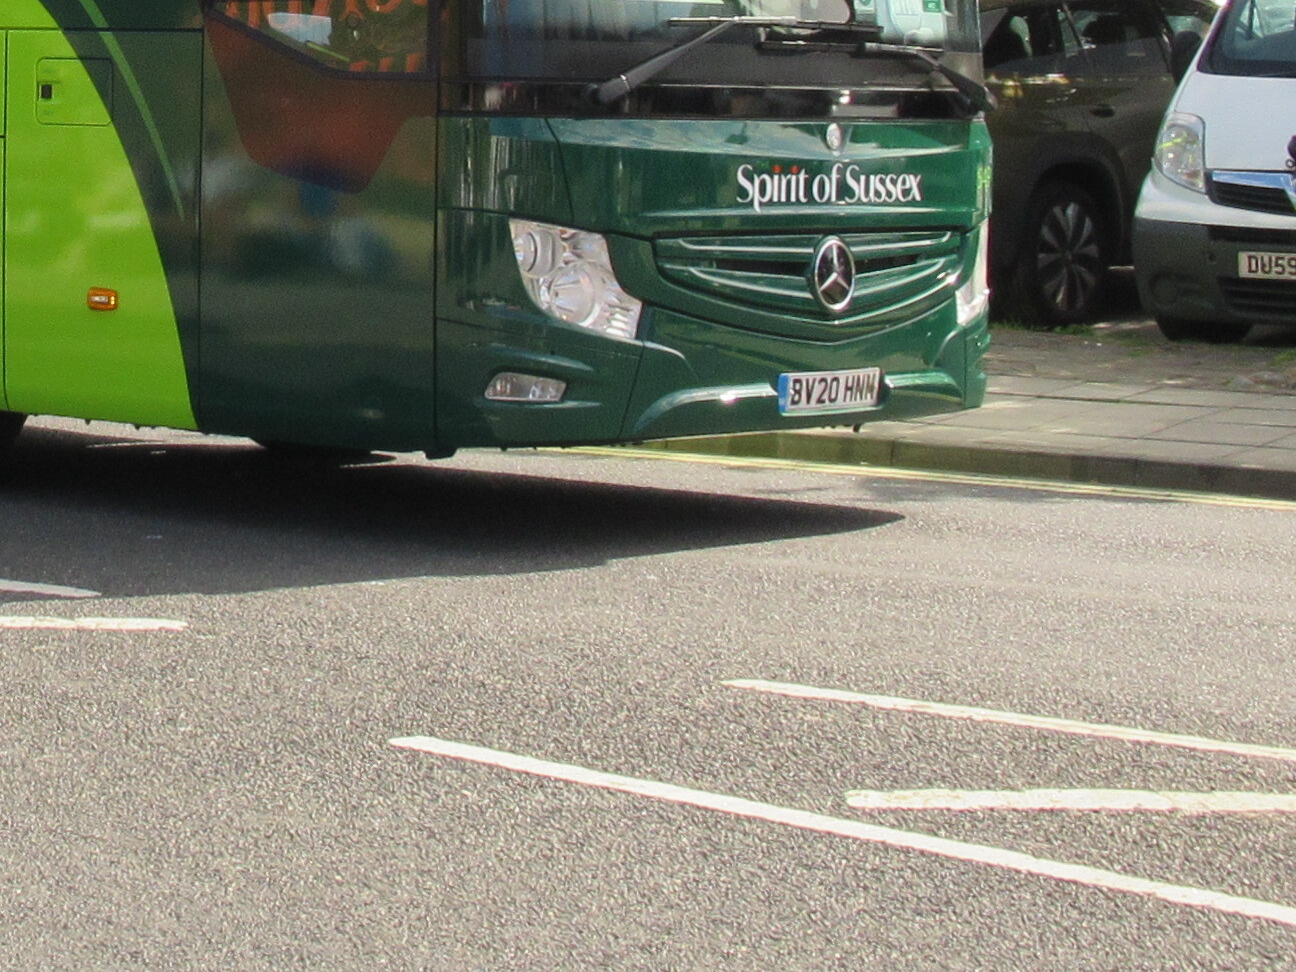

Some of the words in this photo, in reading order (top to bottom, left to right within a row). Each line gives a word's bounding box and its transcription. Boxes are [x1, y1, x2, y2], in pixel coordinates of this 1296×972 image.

[736, 163, 809, 213] Spirit
[812, 163, 843, 203] of
[845, 165, 922, 203] Sussex
[790, 377, 840, 406] BV20
